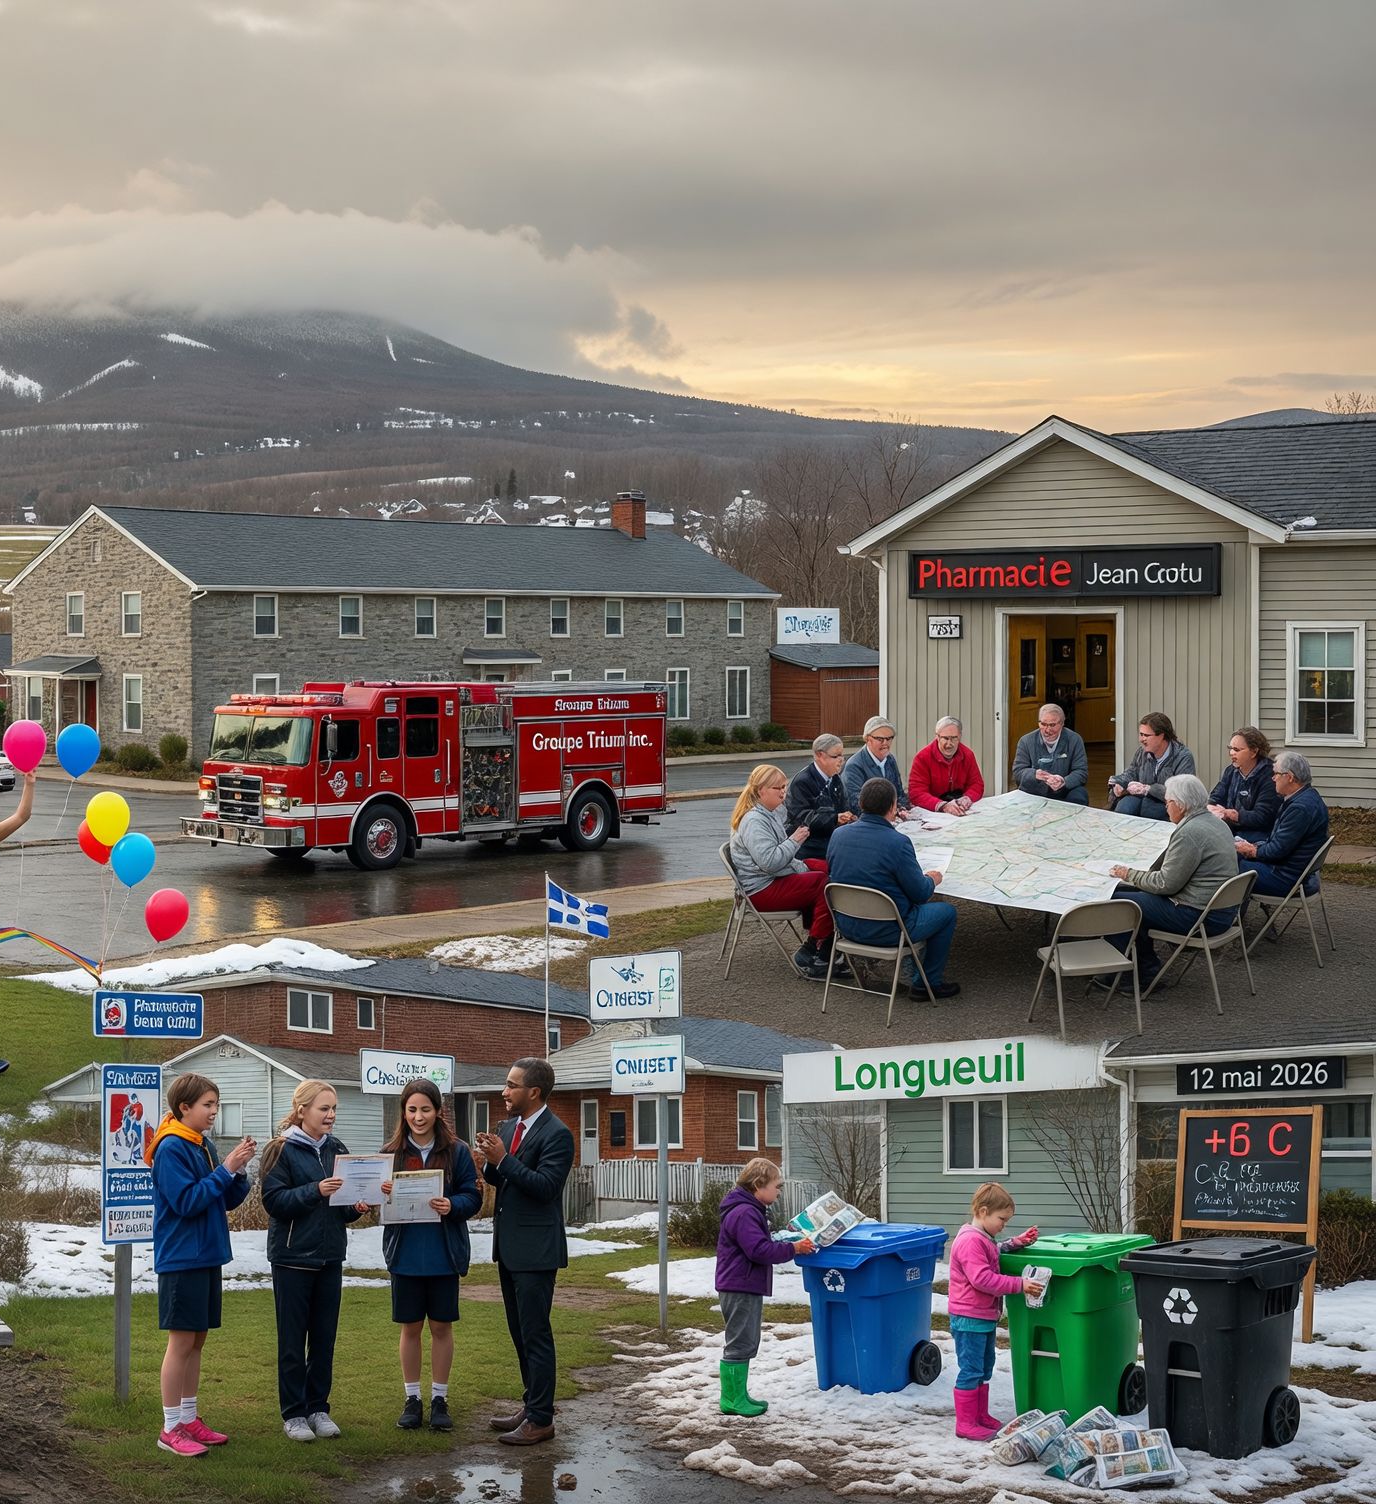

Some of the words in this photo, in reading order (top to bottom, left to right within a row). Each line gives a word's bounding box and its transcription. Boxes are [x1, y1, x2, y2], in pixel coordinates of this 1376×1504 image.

[918, 556, 1072, 588] Pharmacie
[1086, 562, 1139, 585] Jean
[532, 732, 583, 753] Groupe
[586, 730, 625, 748] Trium
[835, 1042, 1024, 1098] Longueuil
[1190, 1067, 1214, 1090] 12
[1222, 1065, 1262, 1088] mai
[1270, 1061, 1329, 1086] 2026
[1204, 1121, 1251, 1157] +6
[1268, 1121, 1293, 1157] C
